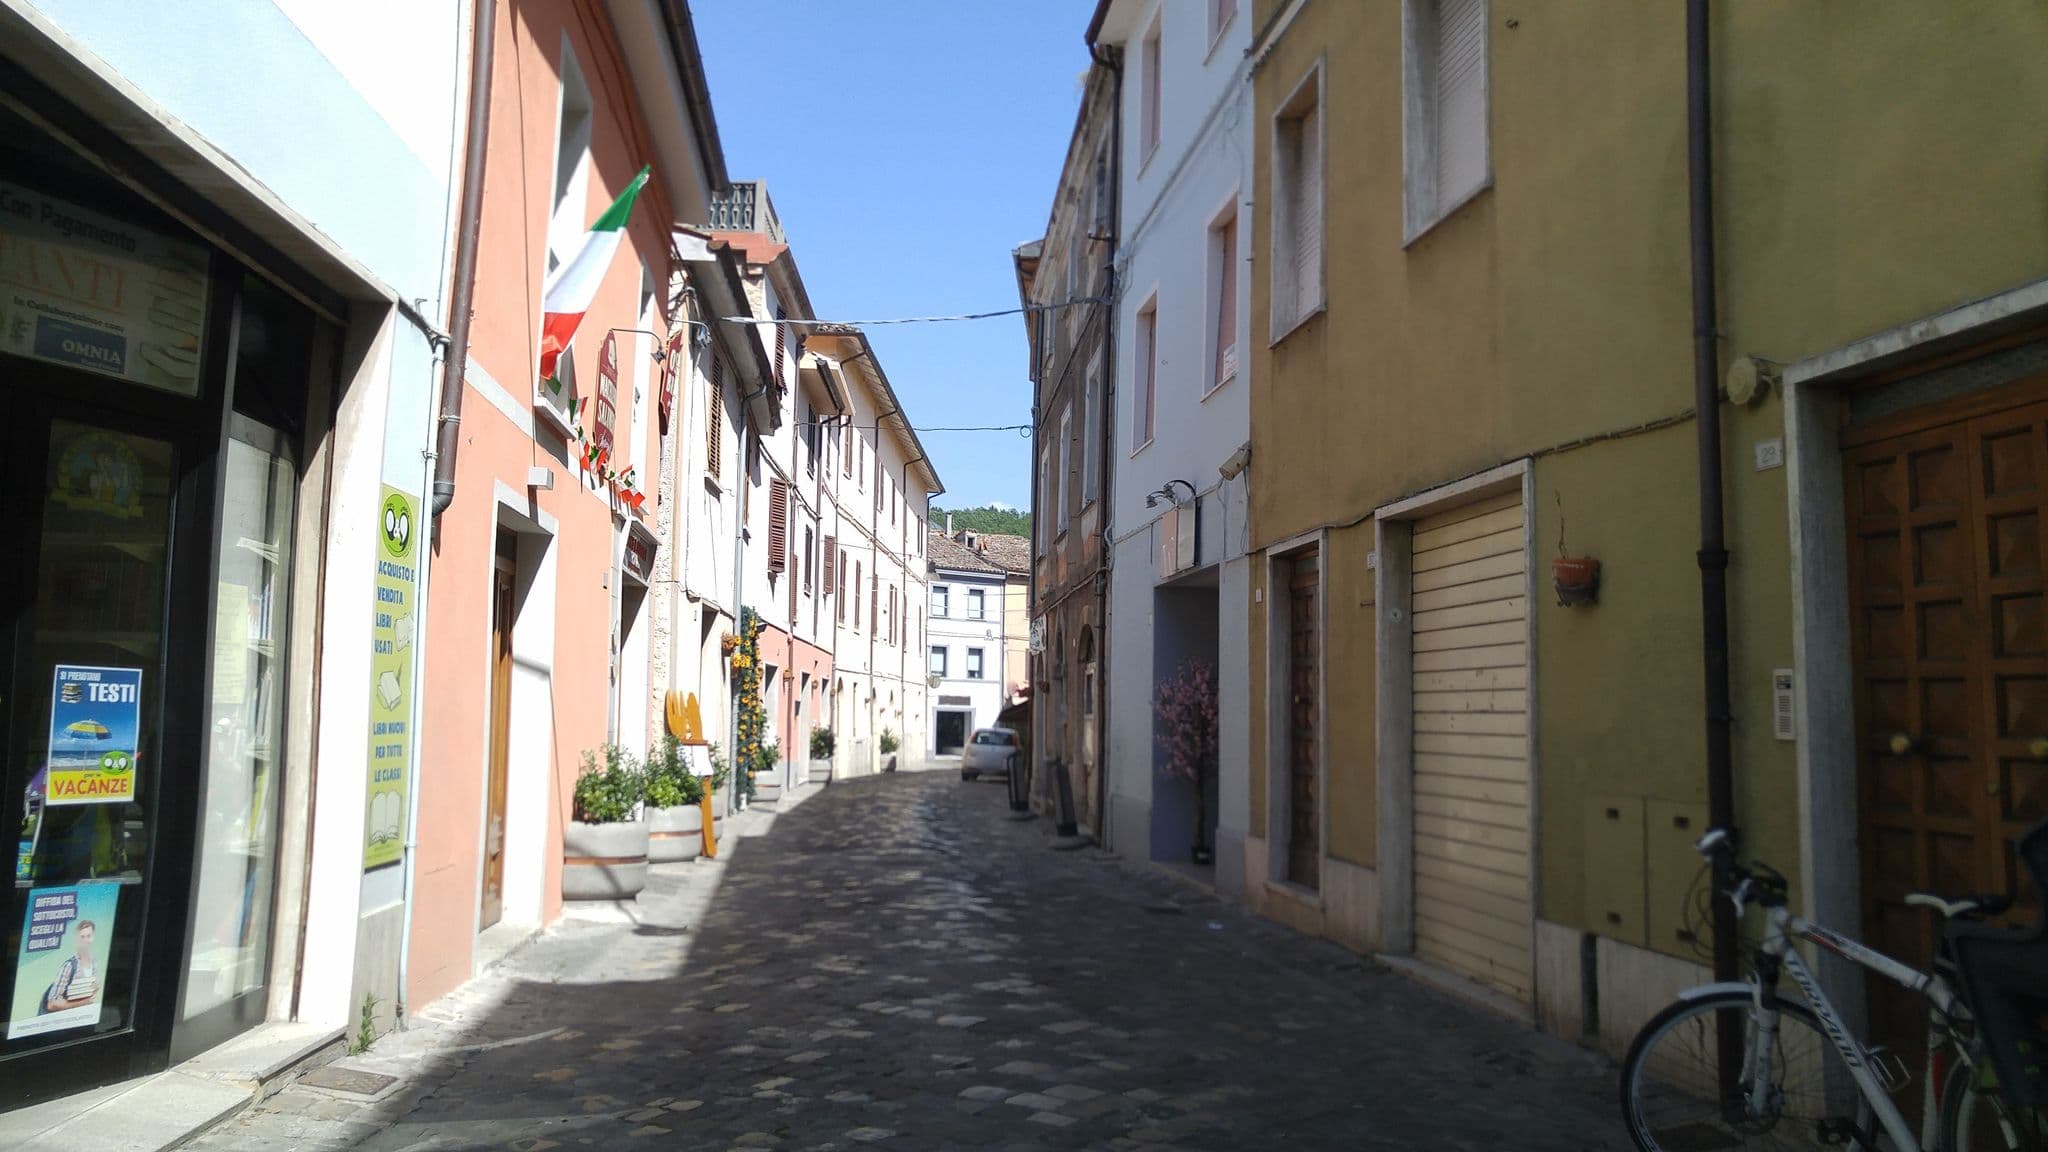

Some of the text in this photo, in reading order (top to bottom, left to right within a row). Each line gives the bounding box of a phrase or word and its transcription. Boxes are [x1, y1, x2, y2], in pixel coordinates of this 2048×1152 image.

[40, 199, 137, 253] Pagamento
[62, 339, 121, 365] OMNIA
[378, 560, 415, 583] ACQUISTO E
[377, 586, 404, 605] VENDITA
[376, 612, 392, 628] LIBRI
[374, 639, 393, 655] USATI
[88, 683, 136, 703] TESTI
[373, 723, 387, 735] LIBRI
[375, 746, 386, 759] PER
[374, 770, 382, 783] LE
[54, 778, 128, 796] VACANZE
